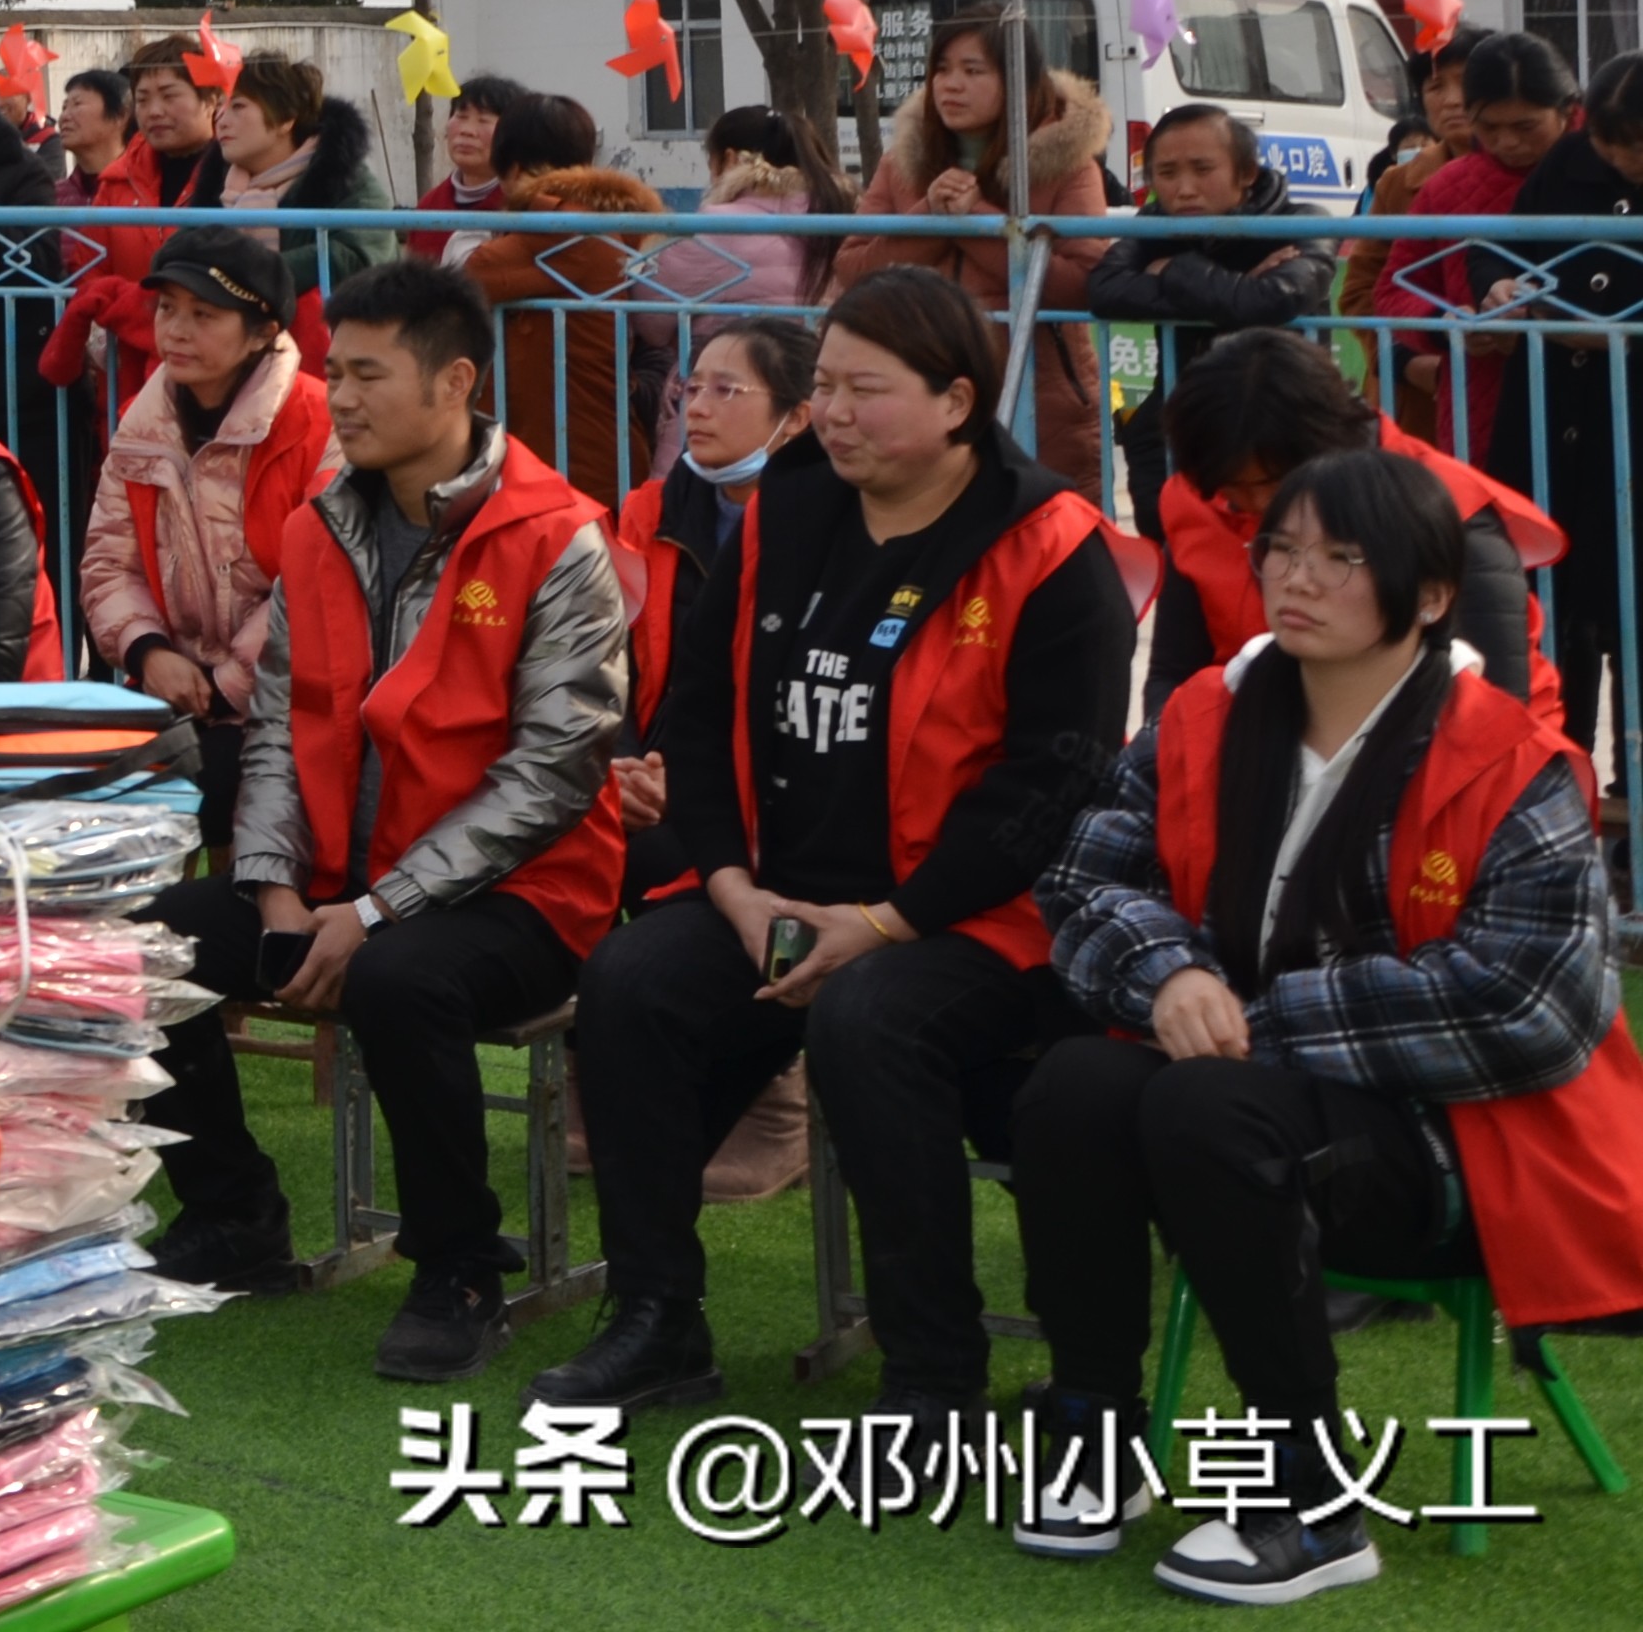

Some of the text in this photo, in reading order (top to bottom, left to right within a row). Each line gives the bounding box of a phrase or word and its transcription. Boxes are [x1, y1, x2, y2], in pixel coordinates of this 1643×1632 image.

[880, 9, 934, 38] 服务
[1257, 142, 1329, 177] 业口腔
[805, 648, 850, 680] THE
